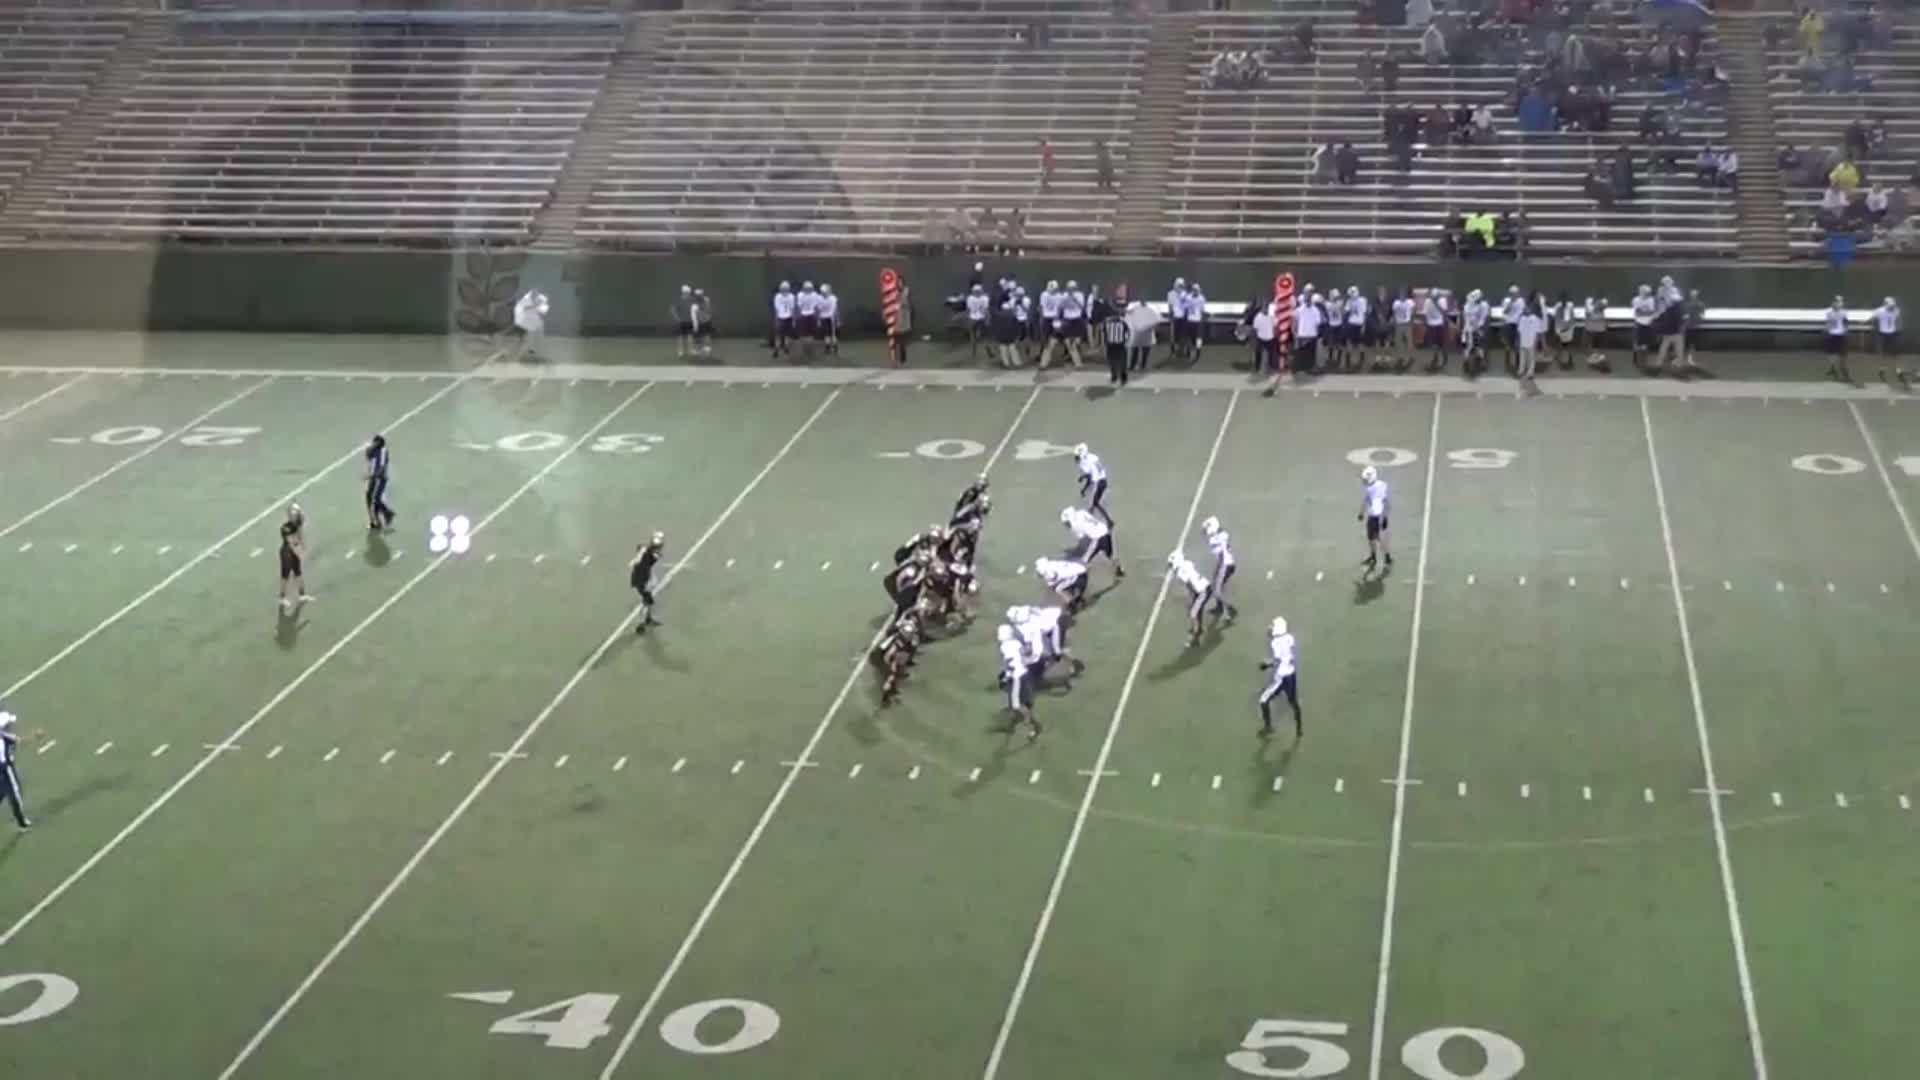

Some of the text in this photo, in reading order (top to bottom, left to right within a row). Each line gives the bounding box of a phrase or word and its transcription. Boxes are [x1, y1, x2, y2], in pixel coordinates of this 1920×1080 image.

[1346, 447, 1518, 468] 50
[489, 992, 781, 1053] 40
[1225, 1018, 1525, 1080] 50
